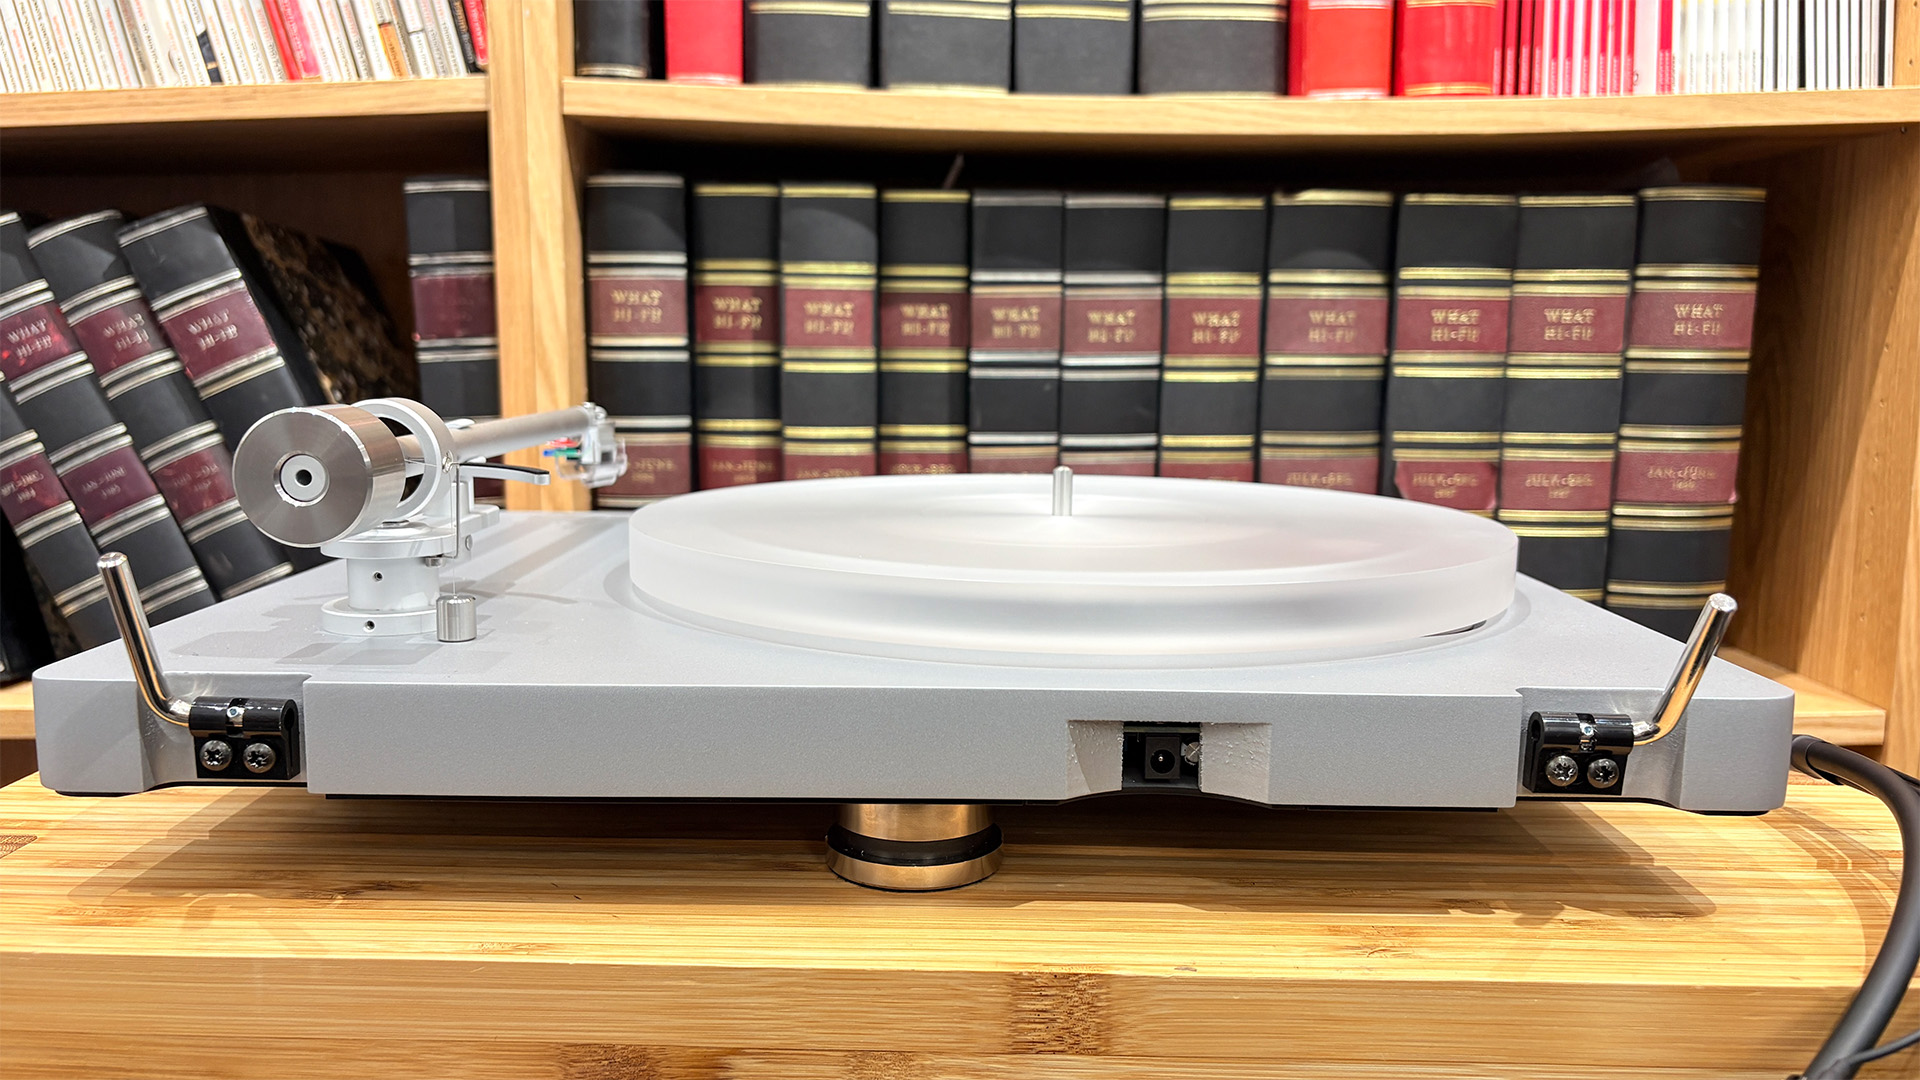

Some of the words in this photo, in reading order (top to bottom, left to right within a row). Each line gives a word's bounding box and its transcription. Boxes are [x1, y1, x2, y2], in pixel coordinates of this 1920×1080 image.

[611, 289, 663, 306] WHAT
[712, 297, 763, 313] WHAT
[803, 301, 855, 318] WHAT
[900, 303, 951, 320] WHAT
[991, 305, 1041, 322] WHAT
[1087, 309, 1136, 326] WHAT
[1431, 309, 1482, 325] WHAT
[1544, 308, 1597, 324] WHAT
[1673, 303, 1725, 319] WHAT
[103, 313, 145, 339] WHAT
[187, 308, 230, 335] WHAT
[1192, 310, 1241, 327] WHAT
[1308, 310, 1357, 327] WHAT
[7, 316, 48, 344] WHAT
